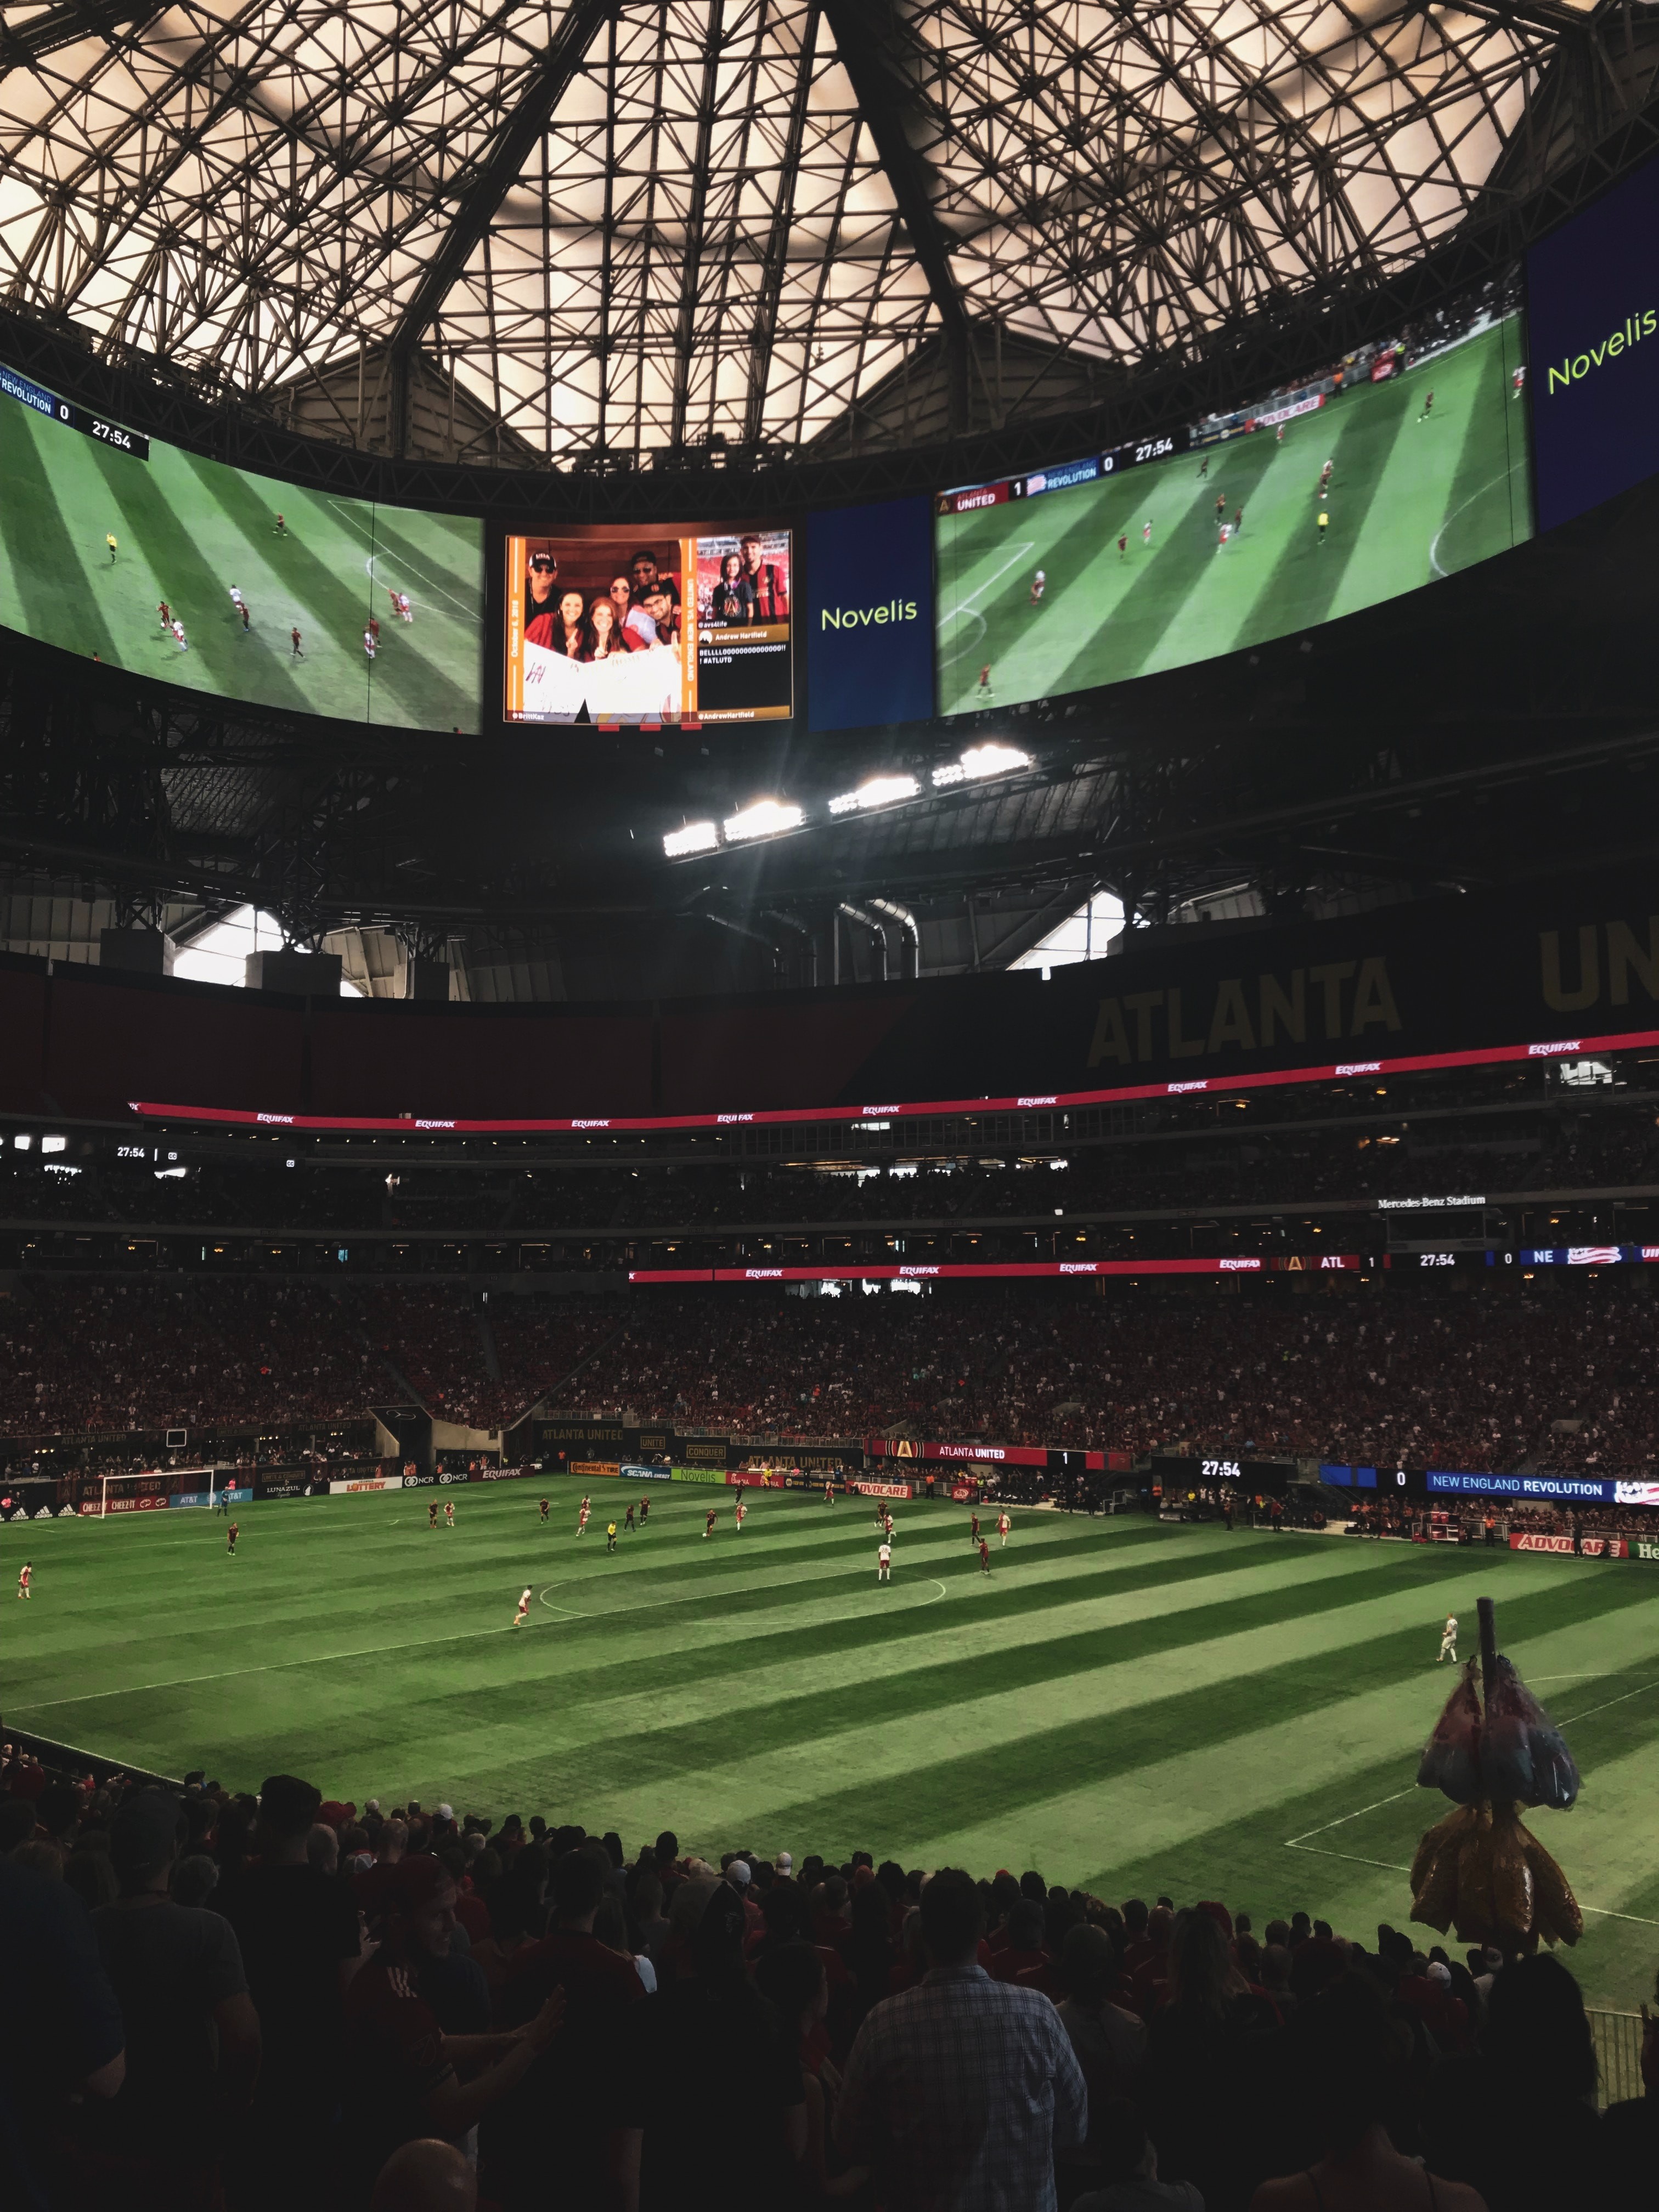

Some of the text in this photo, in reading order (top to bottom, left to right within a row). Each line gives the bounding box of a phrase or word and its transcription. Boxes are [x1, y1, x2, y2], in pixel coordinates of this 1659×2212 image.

[1549, 310, 1657, 394] Novelis
[2, 371, 52, 403] NEW ENGLAND
[2, 378, 51, 414] REVOLUTION
[60, 405, 69, 420] 0
[92, 421, 131, 449] 27:54
[1136, 438, 1173, 461] 27:54
[1104, 457, 1113, 471] 0
[1047, 466, 1096, 489] REVOLUTION
[1014, 481, 1021, 495] 1
[957, 493, 995, 511] UNITED
[822, 599, 918, 631] Novelis
[715, 630, 767, 641] Andrew Hartfield
[1086, 956, 1402, 1068] ATLANTA
[1528, 1041, 1581, 1056] EQUIFAX
[1335, 1062, 1380, 1076] EQUIFAX
[1167, 1081, 1207, 1093] EQUIFAX
[1017, 1097, 1057, 1107] EQUIFAX
[862, 1105, 900, 1115] EQUIFAX
[257, 1113, 294, 1124] EQUIFAX
[415, 1120, 455, 1129] EQUIFAX
[571, 1120, 609, 1129] EQUIFAX
[717, 1113, 753, 1124] EQUIFAX
[117, 1147, 145, 1158] 27:54
[1378, 1197, 1445, 1209] Mercedes-Benz
[1447, 1195, 1486, 1206] Stadium
[1321, 1257, 1345, 1268] ATL
[1369, 1257, 1374, 1267] 1
[1420, 1254, 1455, 1266] 27:54
[1504, 1254, 1512, 1264] 0
[1534, 1251, 1554, 1263] NE
[899, 1266, 939, 1276] EQUIFAX
[1059, 1263, 1097, 1273] EQUIFAX
[1220, 1260, 1260, 1271] EQUIFAX
[746, 1269, 783, 1279] EQUIFAX
[328, 1421, 351, 1430] UNITED
[61, 1434, 127, 1444] ATLANTA UNITED
[542, 1428, 623, 1441] ATLANTA UNITED
[642, 1438, 664, 1447] UNITE
[689, 1446, 724, 1458] CONQUER
[939, 1446, 1005, 1459] ATLANTA UNITED
[1063, 1452, 1068, 1464] 1
[748, 1455, 843, 1468] ATLANTA UNITED
[482, 1468, 522, 1480] EQUIFAX
[572, 1463, 601, 1473] Continental
[627, 1469, 653, 1479] SCANA
[1201, 1460, 1240, 1477] 27:54
[681, 1469, 715, 1483] Novelis
[1397, 1472, 1406, 1485] 0
[82, 1483, 124, 1496] ATLNTA
[347, 1481, 386, 1492] LOTTERY
[1433, 1475, 1602, 1496] NEW ENGLAND REVOLUTION
[180, 1496, 198, 1504] AT&T
[82, 1502, 108, 1513] CHEEZT
[1520, 1536, 1621, 1556] ADVOARE
